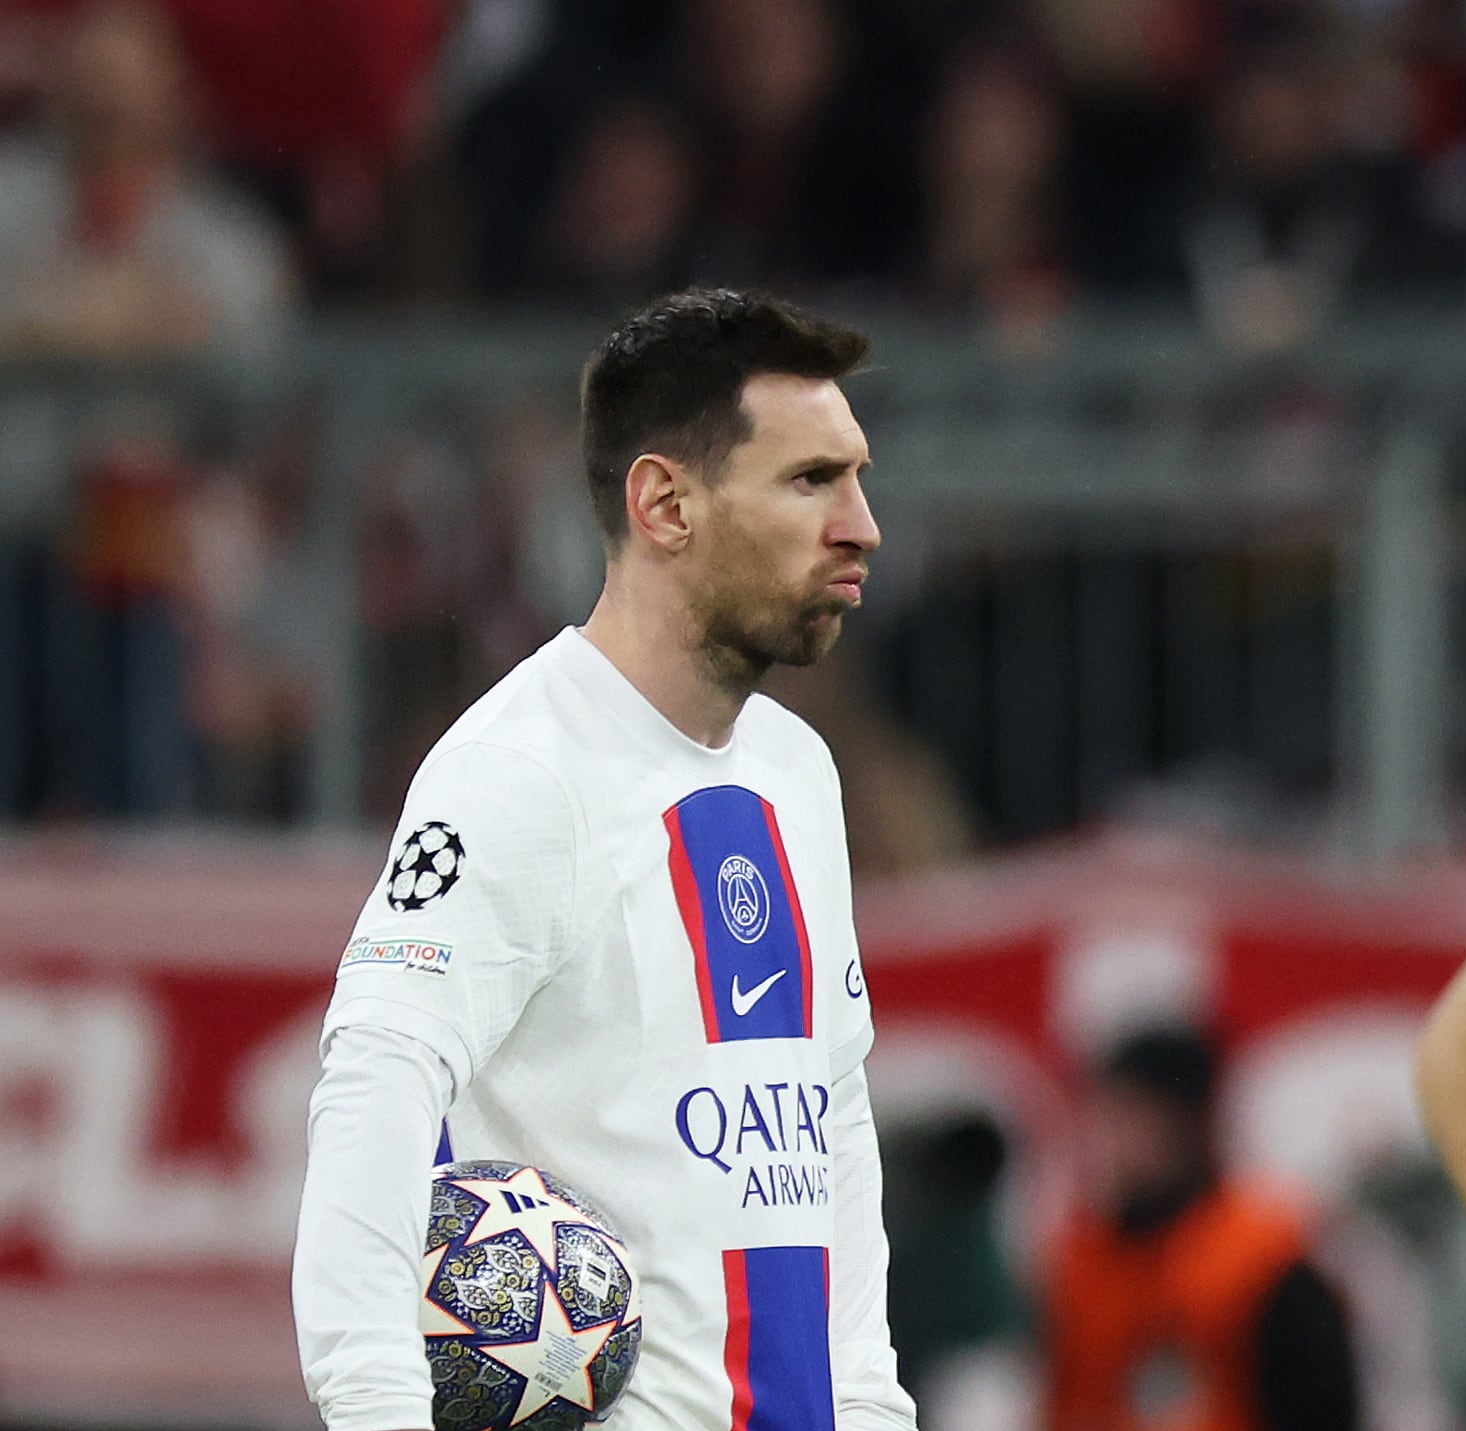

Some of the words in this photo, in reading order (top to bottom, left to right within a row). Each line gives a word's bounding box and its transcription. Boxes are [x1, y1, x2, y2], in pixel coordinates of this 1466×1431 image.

[721, 860, 755, 882] PARIS
[343, 944, 452, 964] FOUNDATION
[674, 1082, 829, 1175] QATAR
